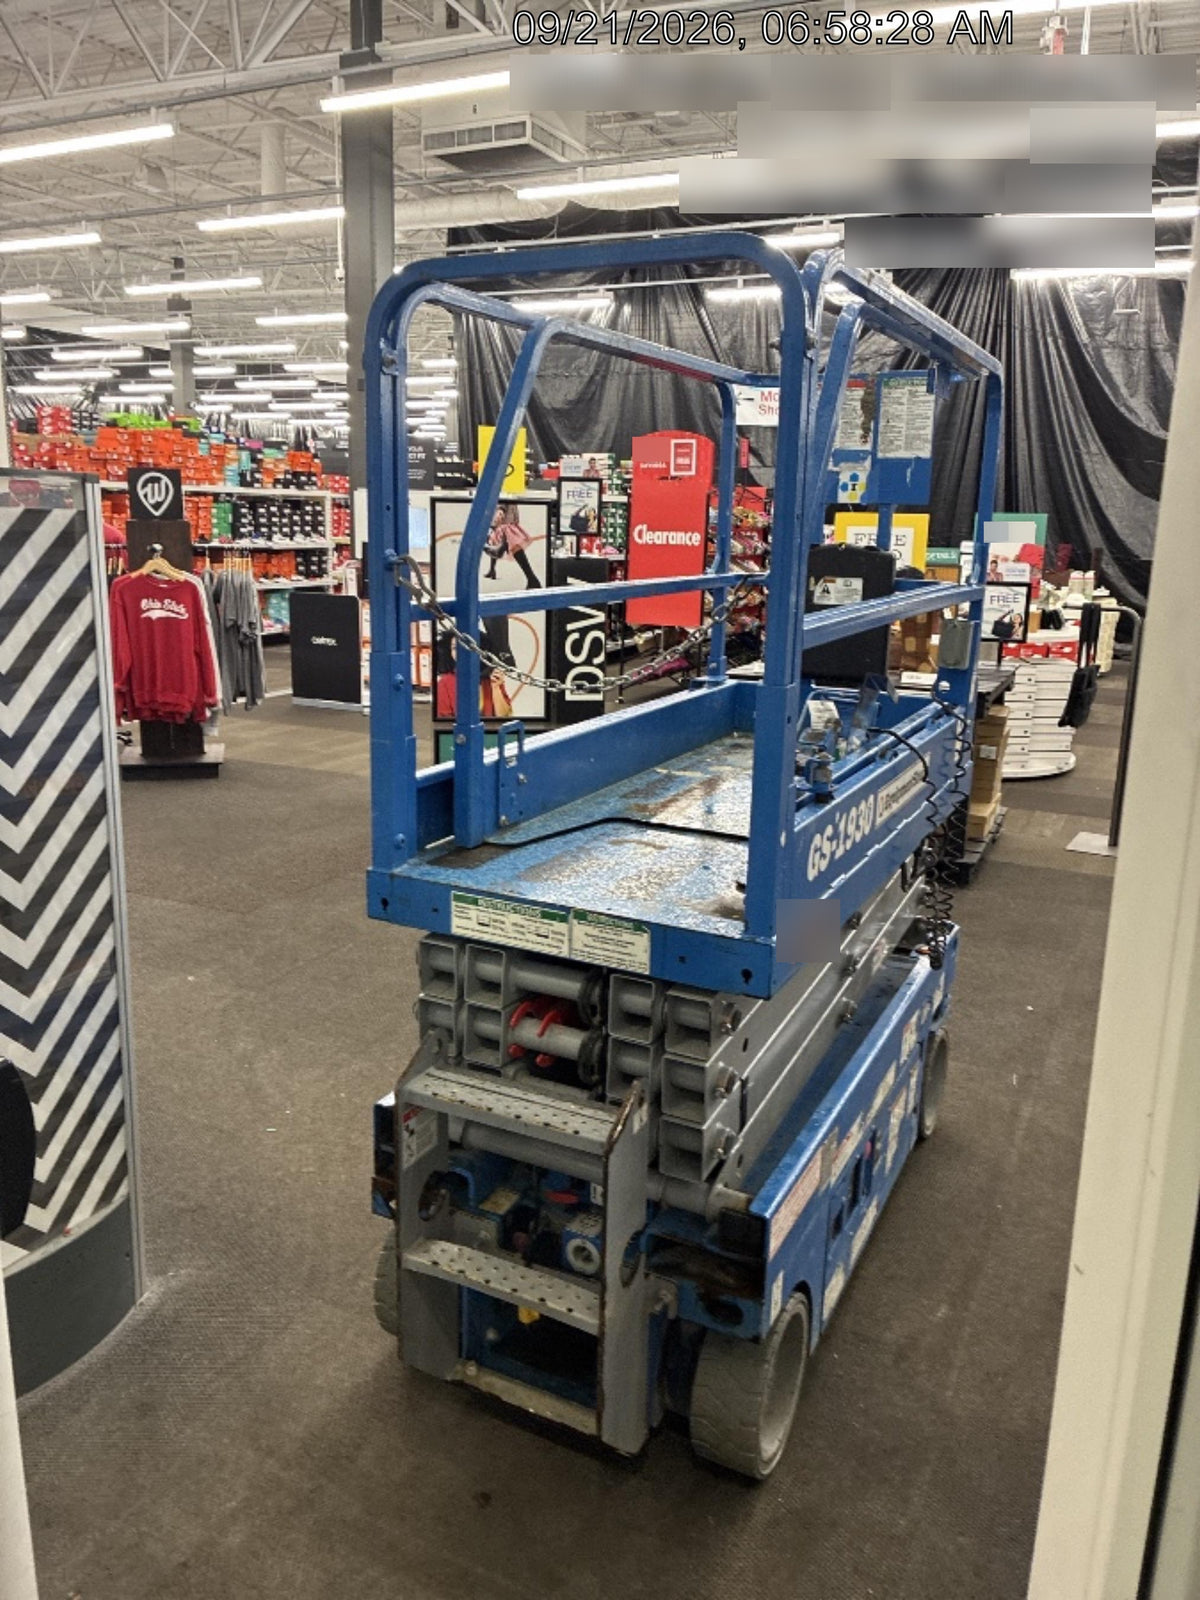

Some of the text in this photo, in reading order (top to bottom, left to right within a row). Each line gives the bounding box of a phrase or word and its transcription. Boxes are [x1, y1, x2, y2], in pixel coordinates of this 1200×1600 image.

[566, 490, 593, 499] FREE
[633, 523, 701, 547] Clearance
[853, 532, 907, 546] FRE
[990, 593, 1020, 605] FREE
[806, 794, 875, 882] GS-1930
